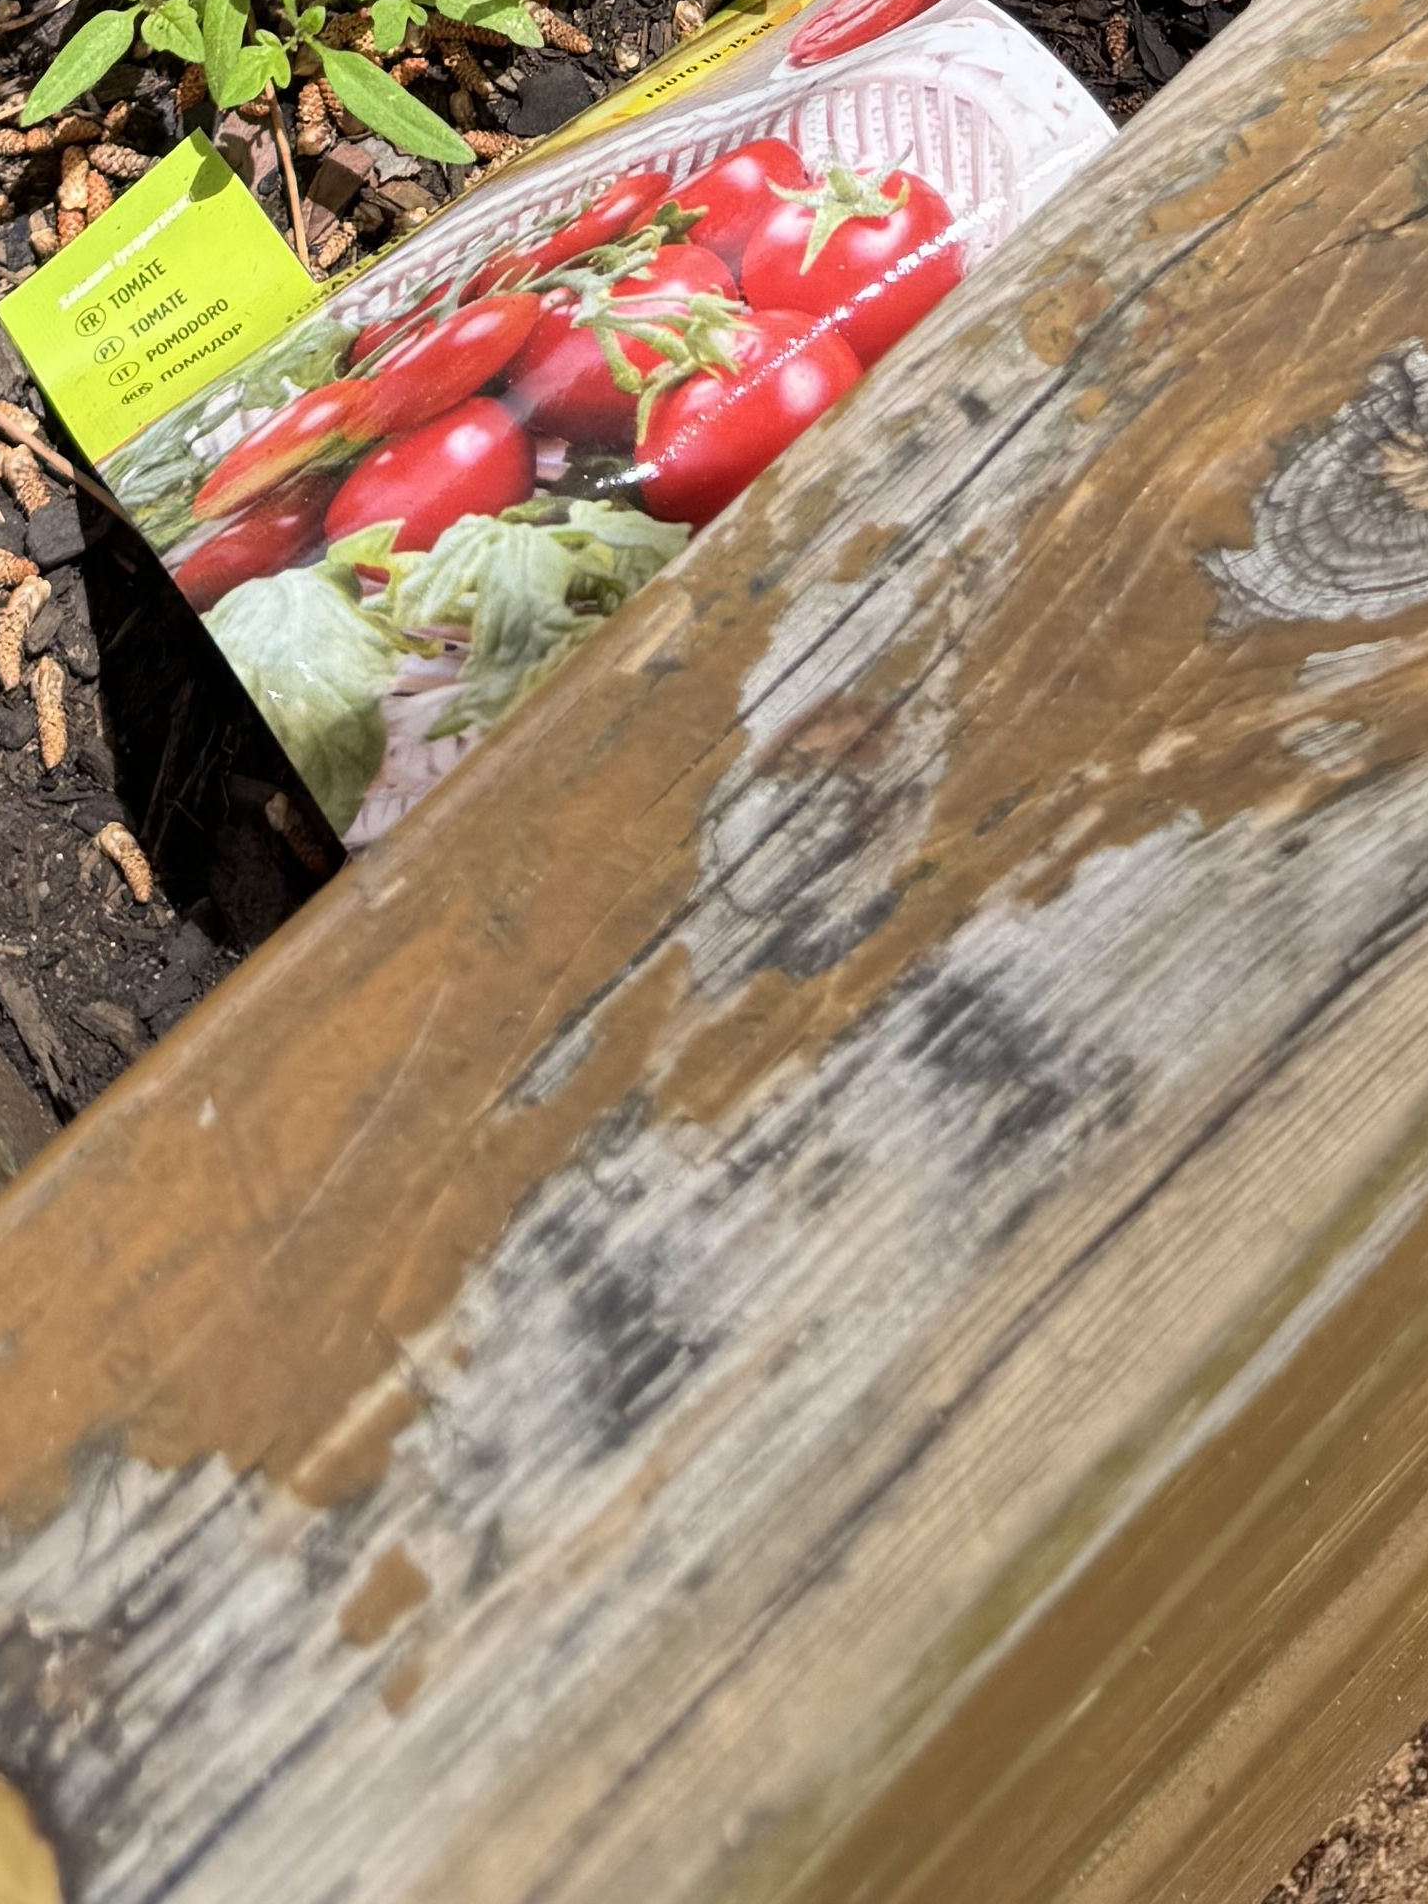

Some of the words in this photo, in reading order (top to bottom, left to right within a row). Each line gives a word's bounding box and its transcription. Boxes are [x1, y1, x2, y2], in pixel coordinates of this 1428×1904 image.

[645, 65, 699, 98] FRUTO
[701, 38, 747, 64] 10-15
[750, 22, 775, 36] GR
[79, 311, 101, 333] FR
[108, 257, 167, 310] TOMATE
[99, 341, 118, 360] PT
[128, 288, 188, 338] TOMATE
[145, 298, 229, 363] POMODORO
[160, 322, 243, 383] ПОМИДОР
